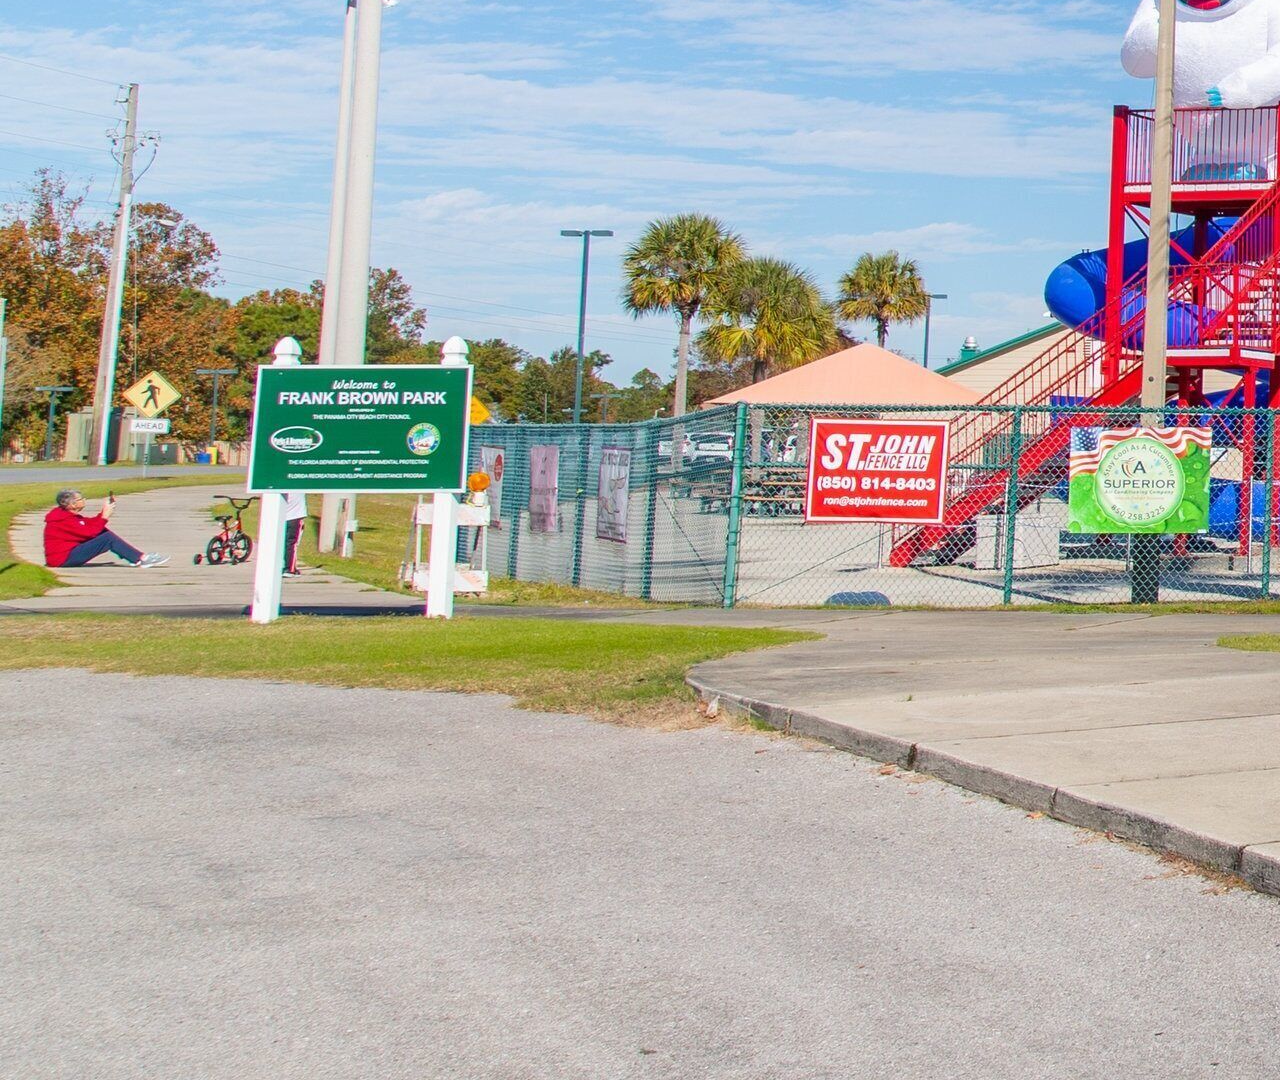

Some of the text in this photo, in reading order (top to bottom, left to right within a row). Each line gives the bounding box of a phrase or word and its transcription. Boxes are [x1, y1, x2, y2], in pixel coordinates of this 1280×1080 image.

[332, 380, 396, 390] Welcome to
[278, 391, 447, 405] FRANK BROWN PARK
[135, 422, 164, 430] AHEAD
[821, 433, 936, 470] ST. JOHN
[866, 454, 928, 470] FENCE LLC
[1104, 443, 1175, 477] Stay Cool As A Cucumber
[817, 476, 936, 491] (850) 814-8403
[1103, 479, 1176, 489] SUPERIOR
[823, 496, 928, 507] ron@stjohnfence.com
[1111, 504, 1165, 521] 850.258.3225
